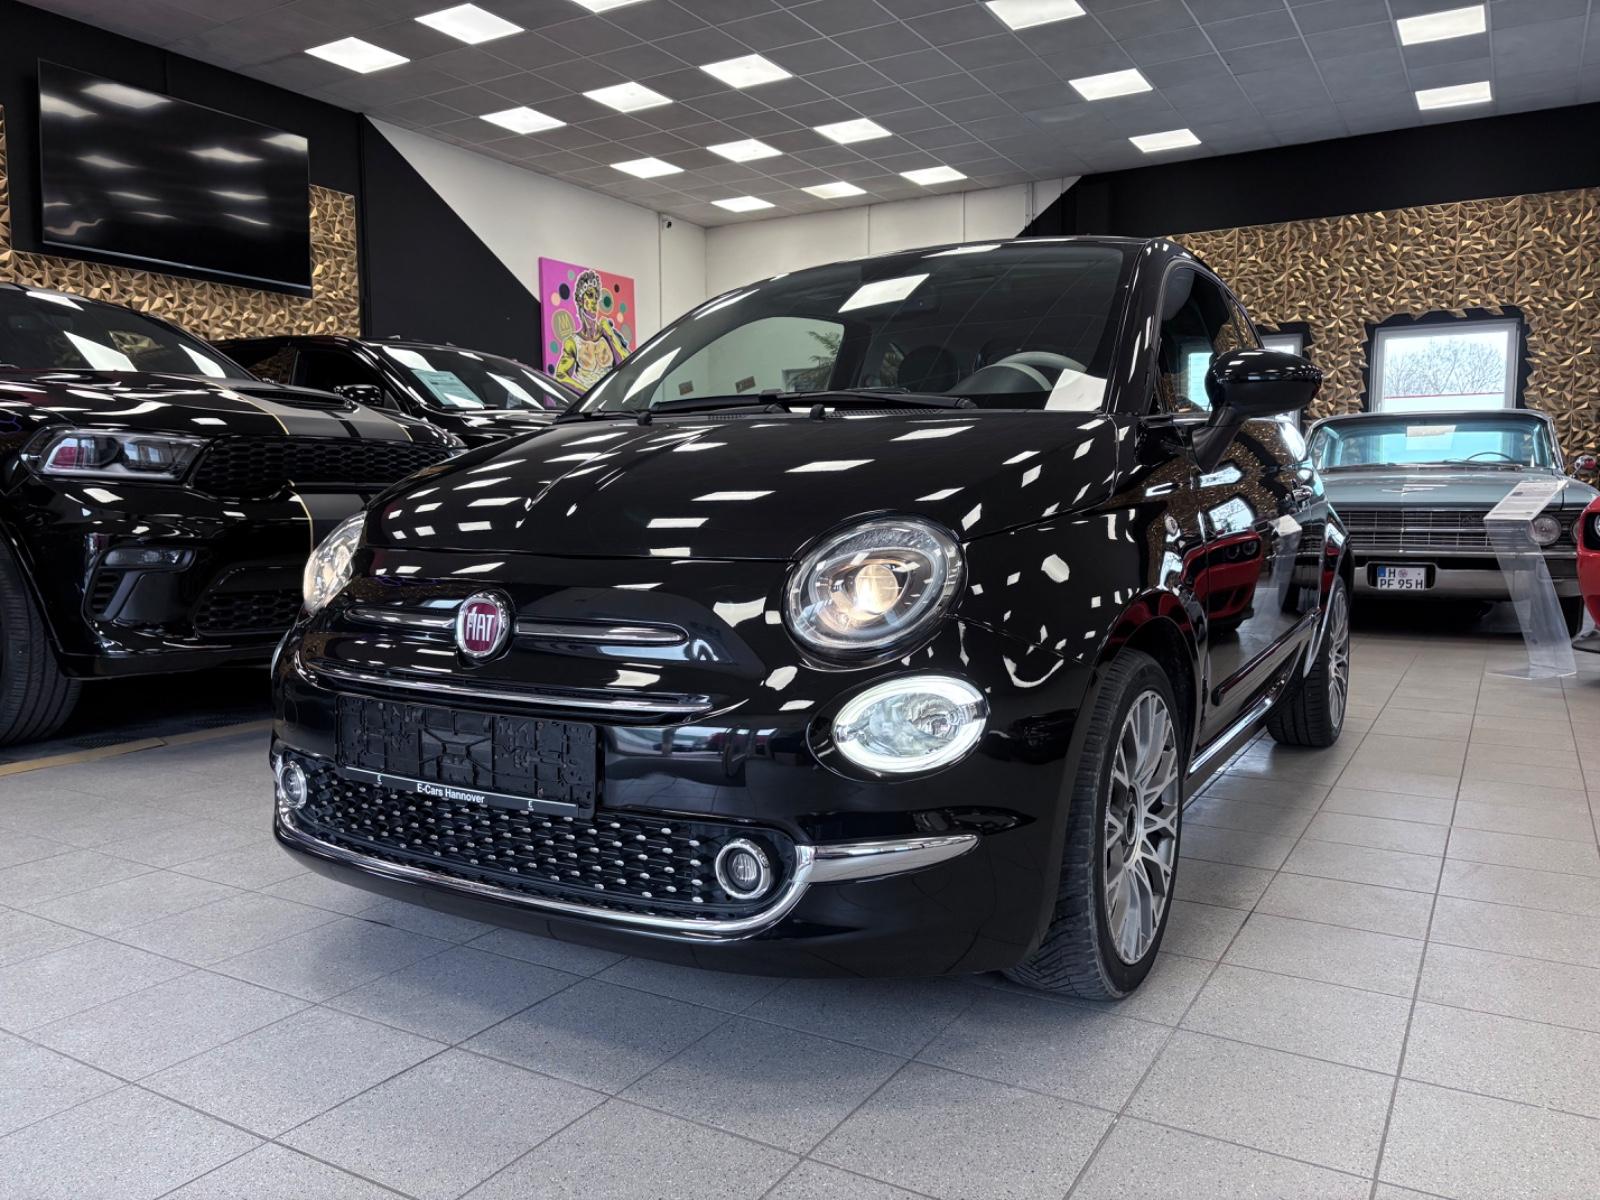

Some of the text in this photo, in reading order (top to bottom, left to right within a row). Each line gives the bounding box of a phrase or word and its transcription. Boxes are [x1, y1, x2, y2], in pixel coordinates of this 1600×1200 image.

[1388, 568, 1396, 578] H
[1379, 578, 1424, 589] PF 95 H
[465, 606, 495, 641] FIAT
[416, 782, 485, 804] E-Cars Hannover
